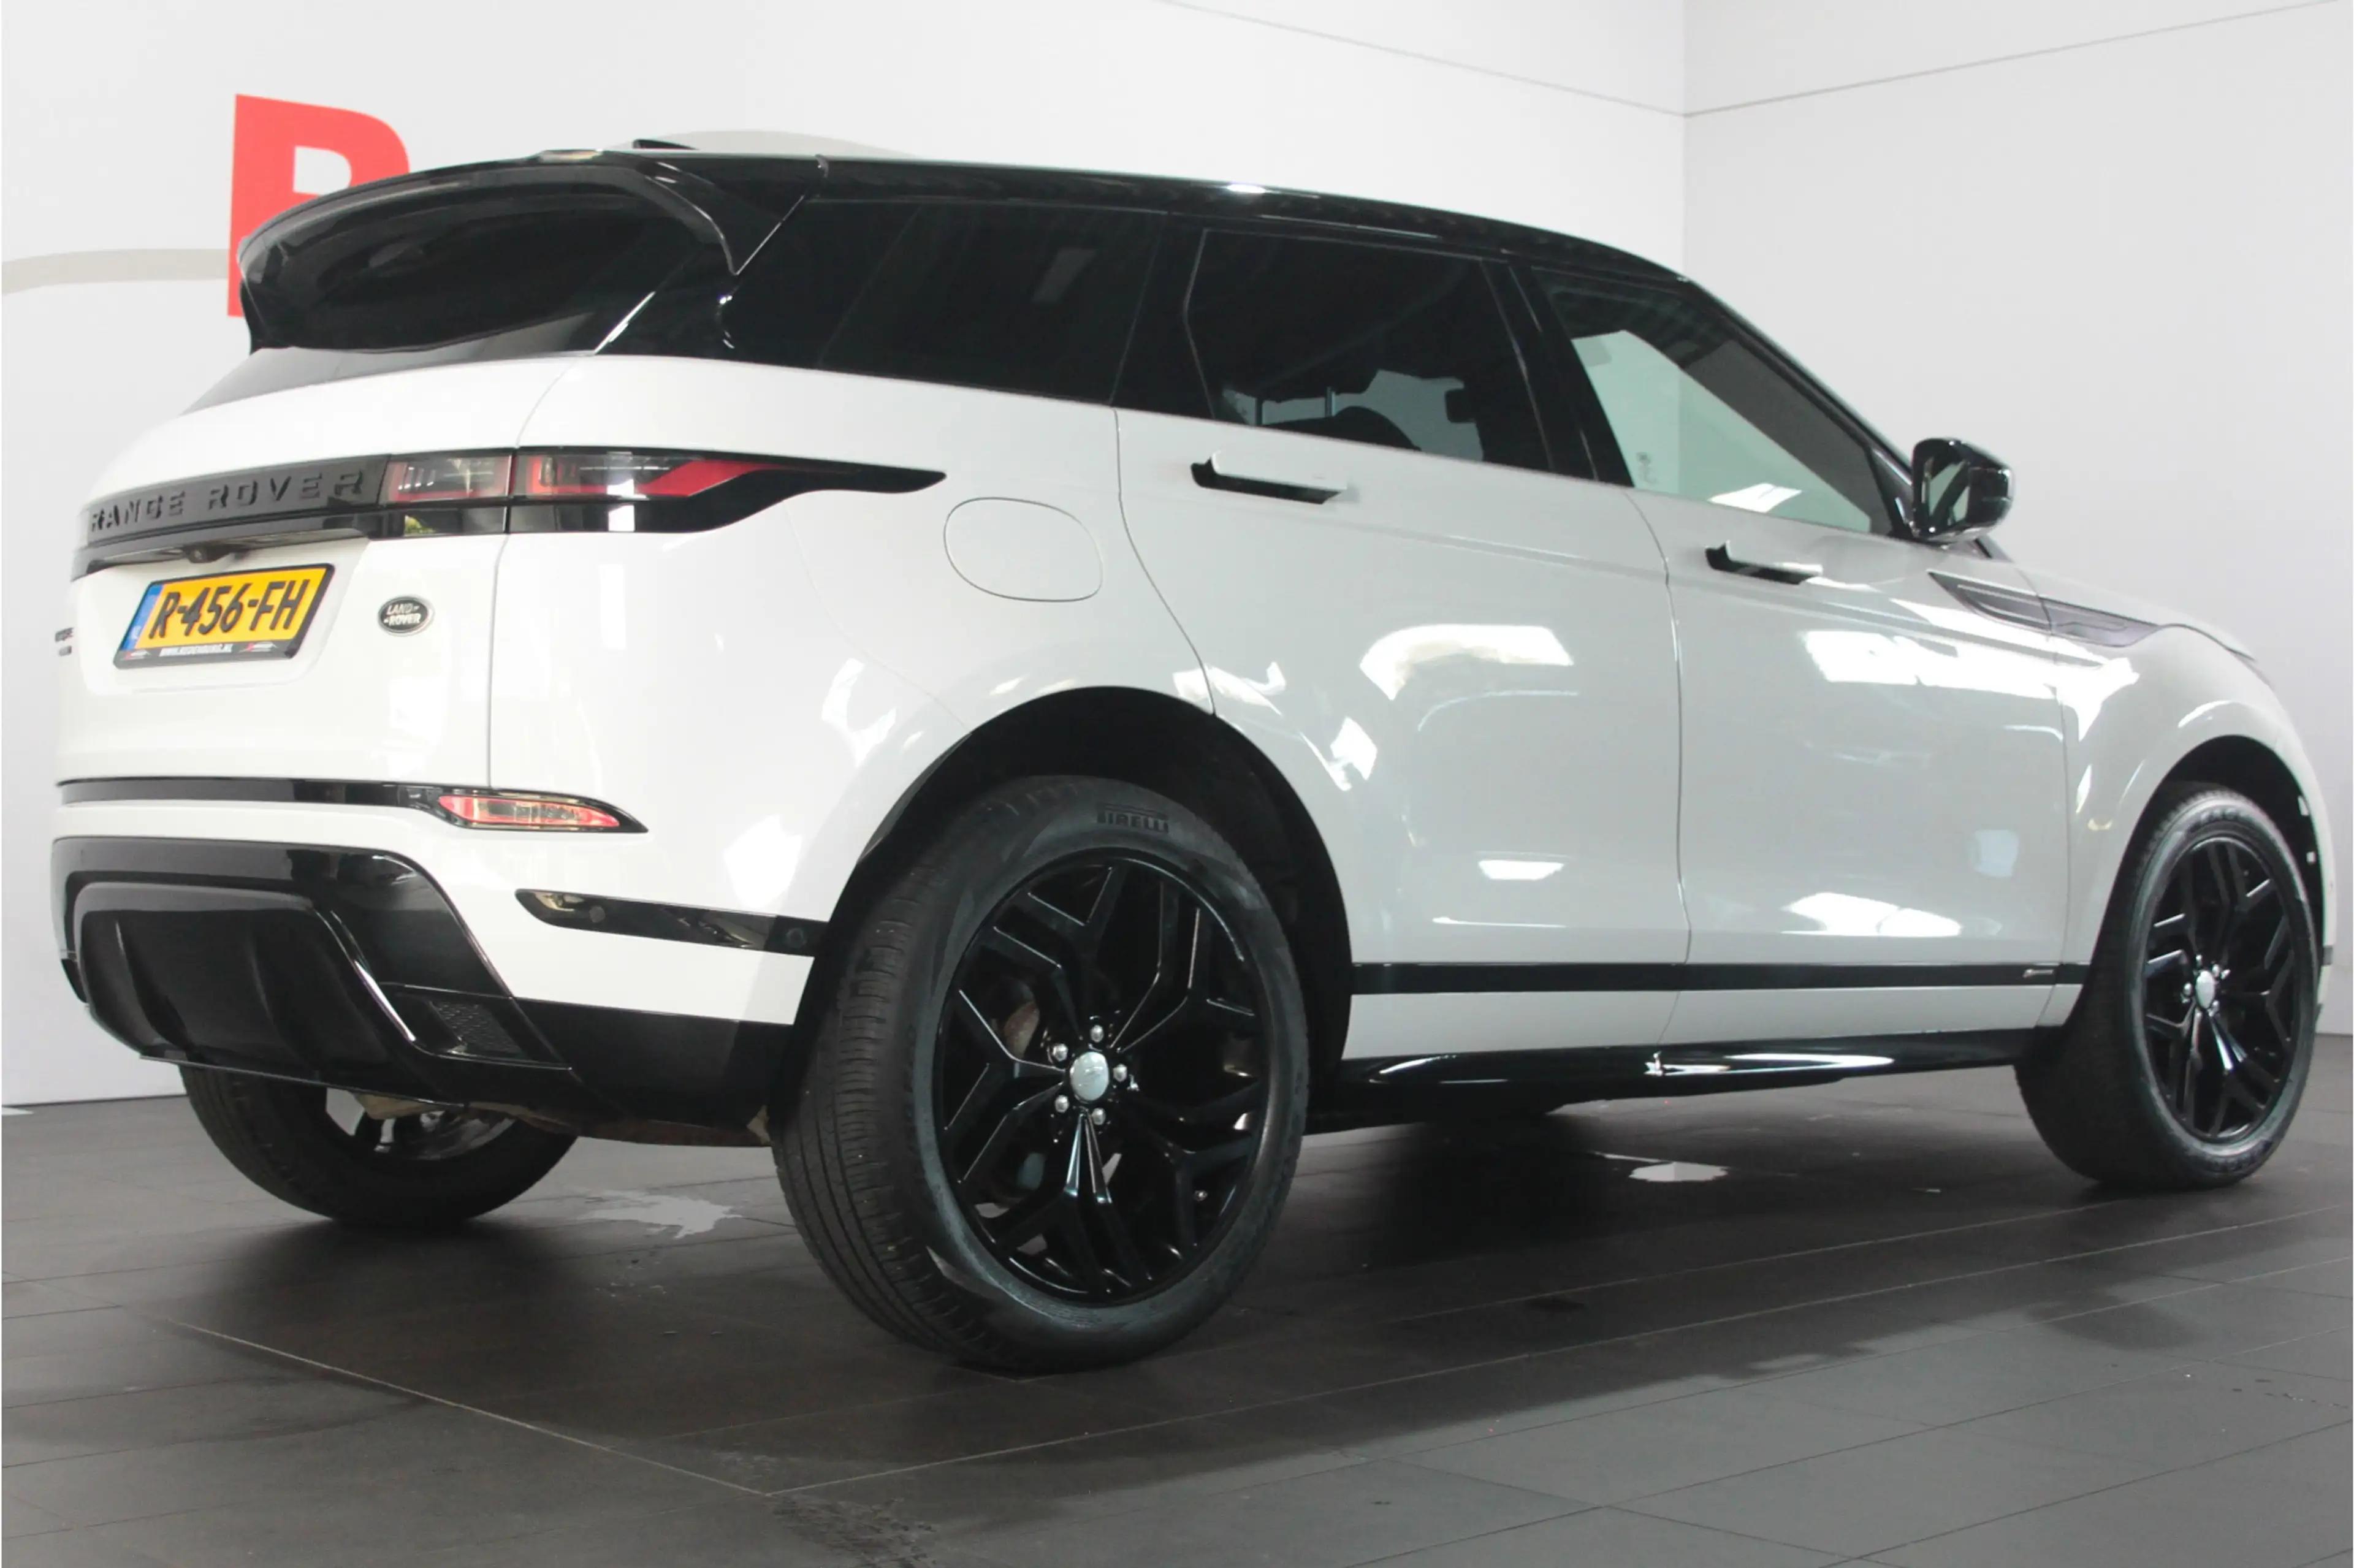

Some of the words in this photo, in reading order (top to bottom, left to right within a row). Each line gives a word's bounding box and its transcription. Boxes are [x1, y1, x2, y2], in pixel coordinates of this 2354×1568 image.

[91, 491, 186, 532] RANGE
[208, 470, 365, 511] ROVER
[148, 578, 311, 639] R-456-FH
[386, 603, 414, 615] LAND
[1096, 802, 1170, 834] PIRELLI
